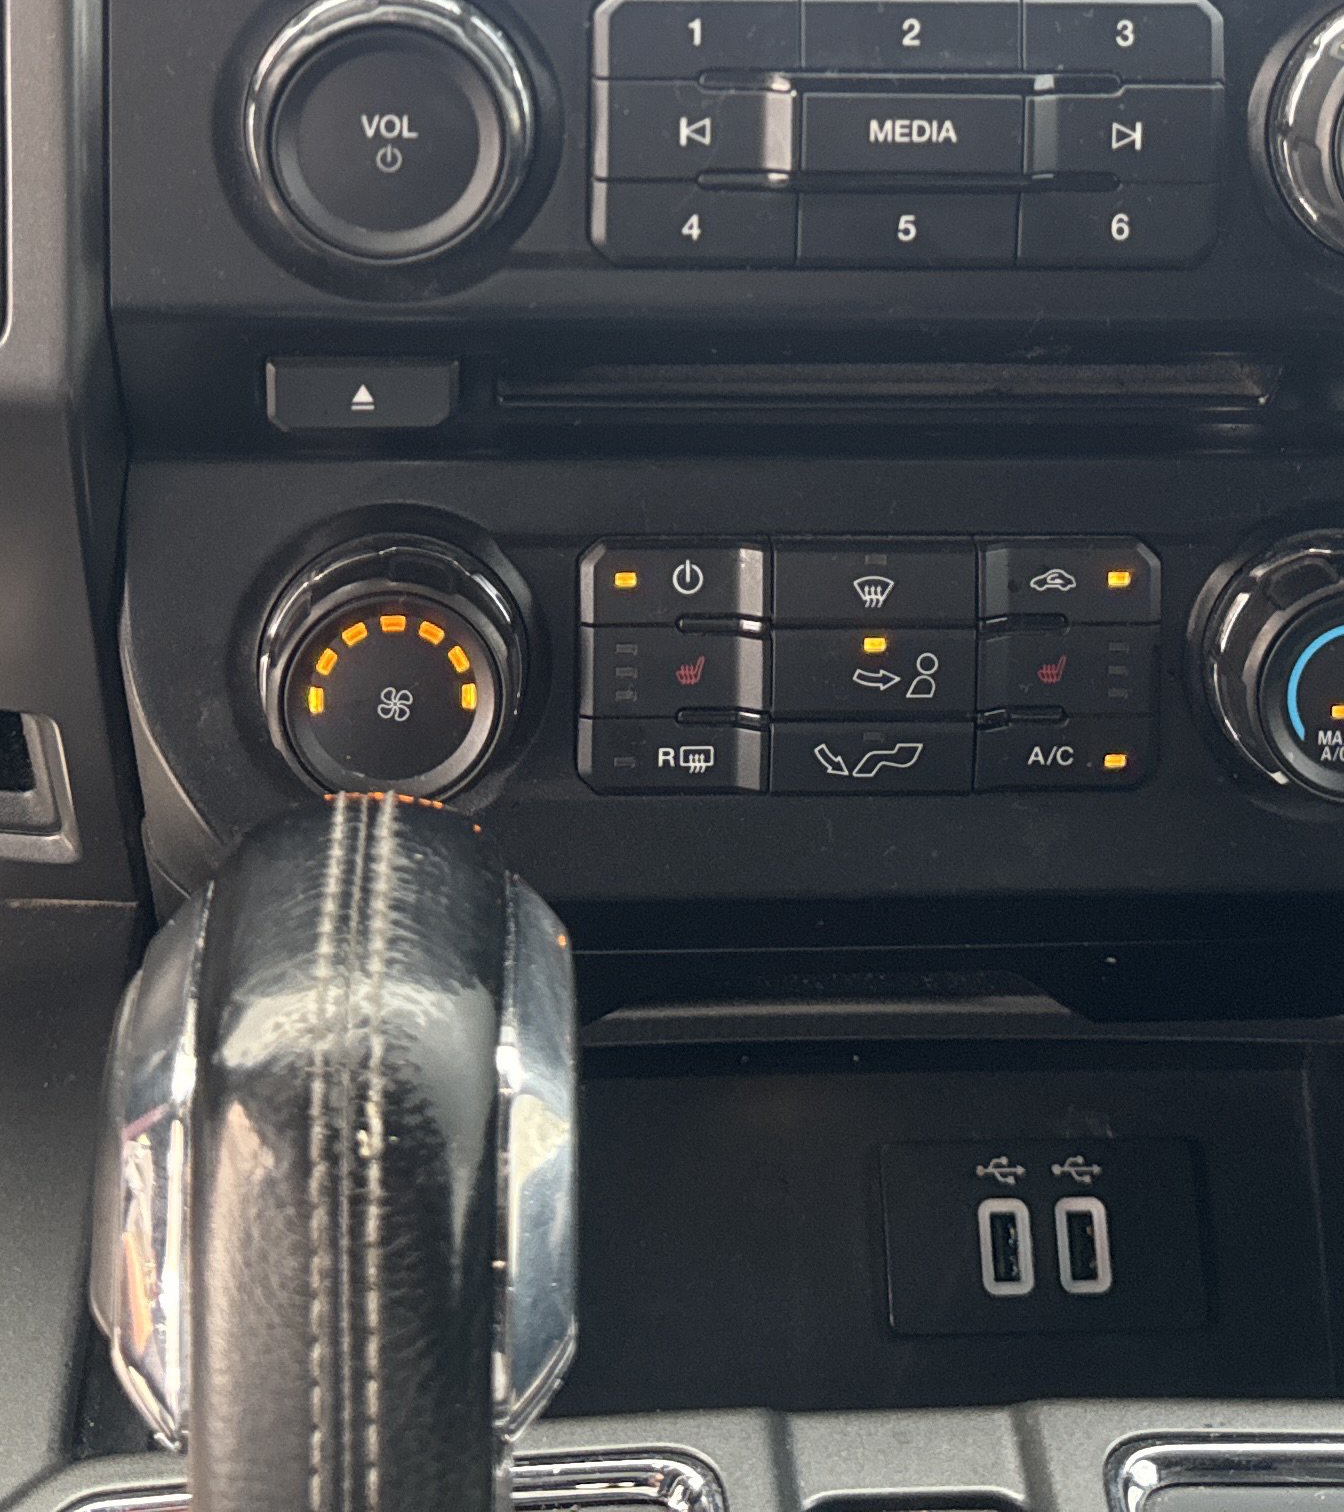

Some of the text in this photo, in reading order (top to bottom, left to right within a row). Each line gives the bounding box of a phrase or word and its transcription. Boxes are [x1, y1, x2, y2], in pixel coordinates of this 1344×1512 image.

[688, 18, 703, 45] 1
[901, 19, 921, 46] 2
[1115, 21, 1135, 46] 3
[361, 114, 419, 138] VOL
[869, 119, 957, 144] MEDIA
[681, 214, 702, 240] 4
[896, 215, 917, 241] 5
[1110, 214, 1130, 240] 6
[658, 749, 674, 768] R
[1027, 745, 1075, 767] A/C
